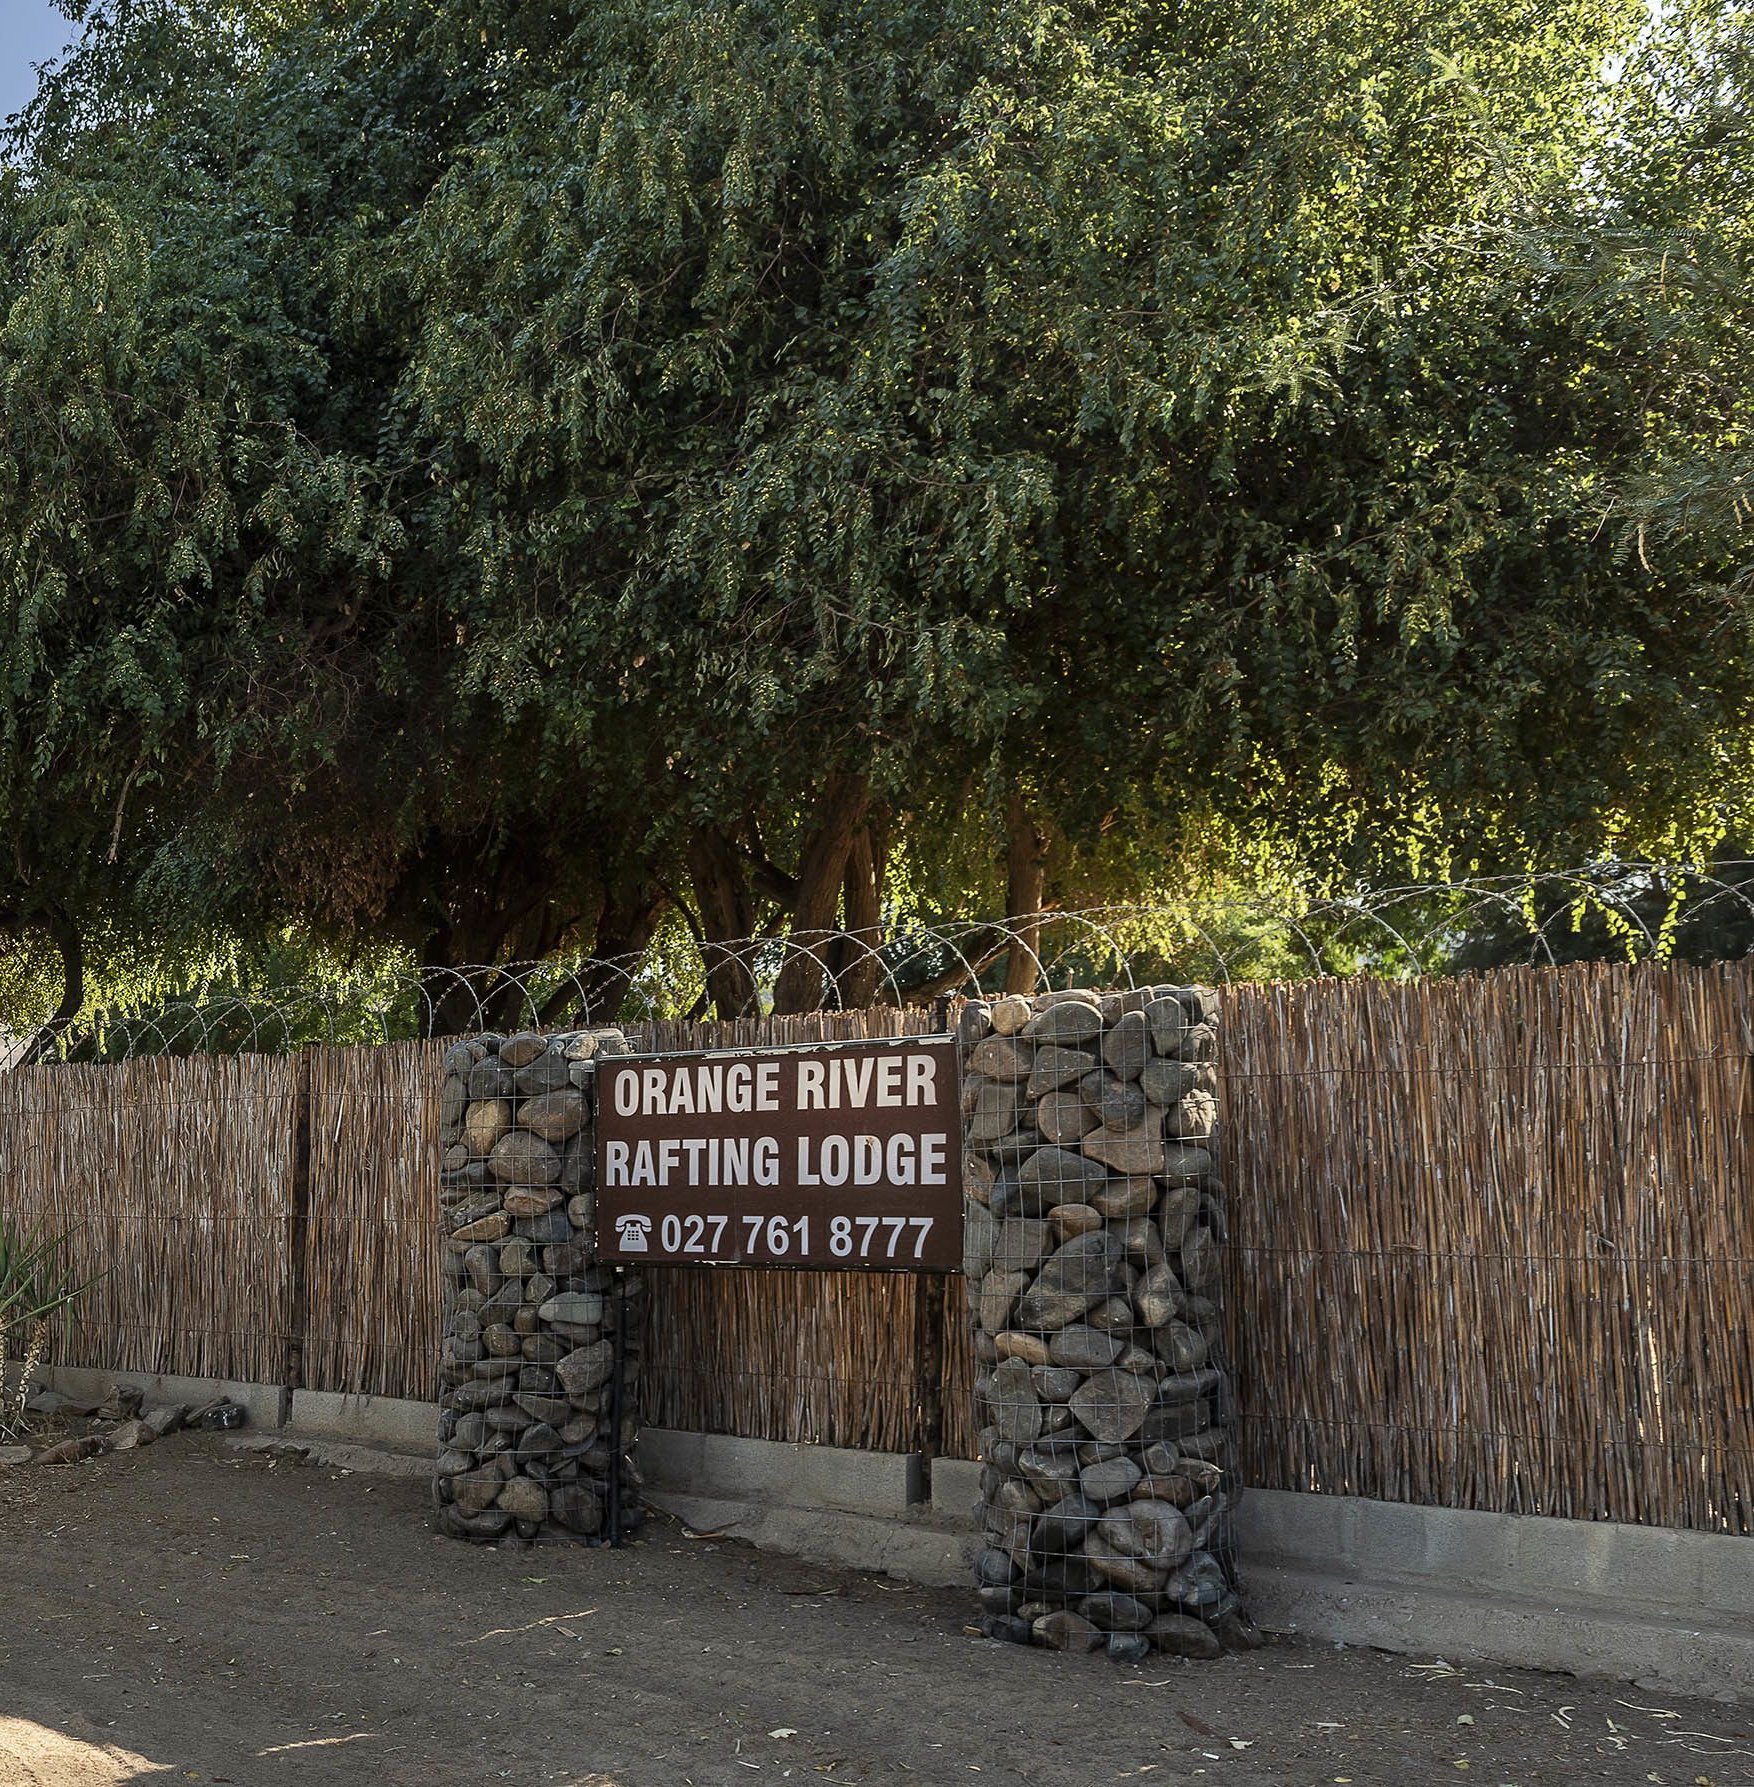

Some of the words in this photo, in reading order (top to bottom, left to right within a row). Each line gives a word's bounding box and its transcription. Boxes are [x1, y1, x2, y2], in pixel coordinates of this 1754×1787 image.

[614, 1062, 780, 1117] ORANGE
[797, 1054, 938, 1110] RIVER
[606, 1136, 780, 1187] RAFTING
[797, 1133, 947, 1186] LODGE
[661, 1214, 728, 1253] 027
[742, 1215, 809, 1256] 761
[829, 1216, 934, 1258] 8777
